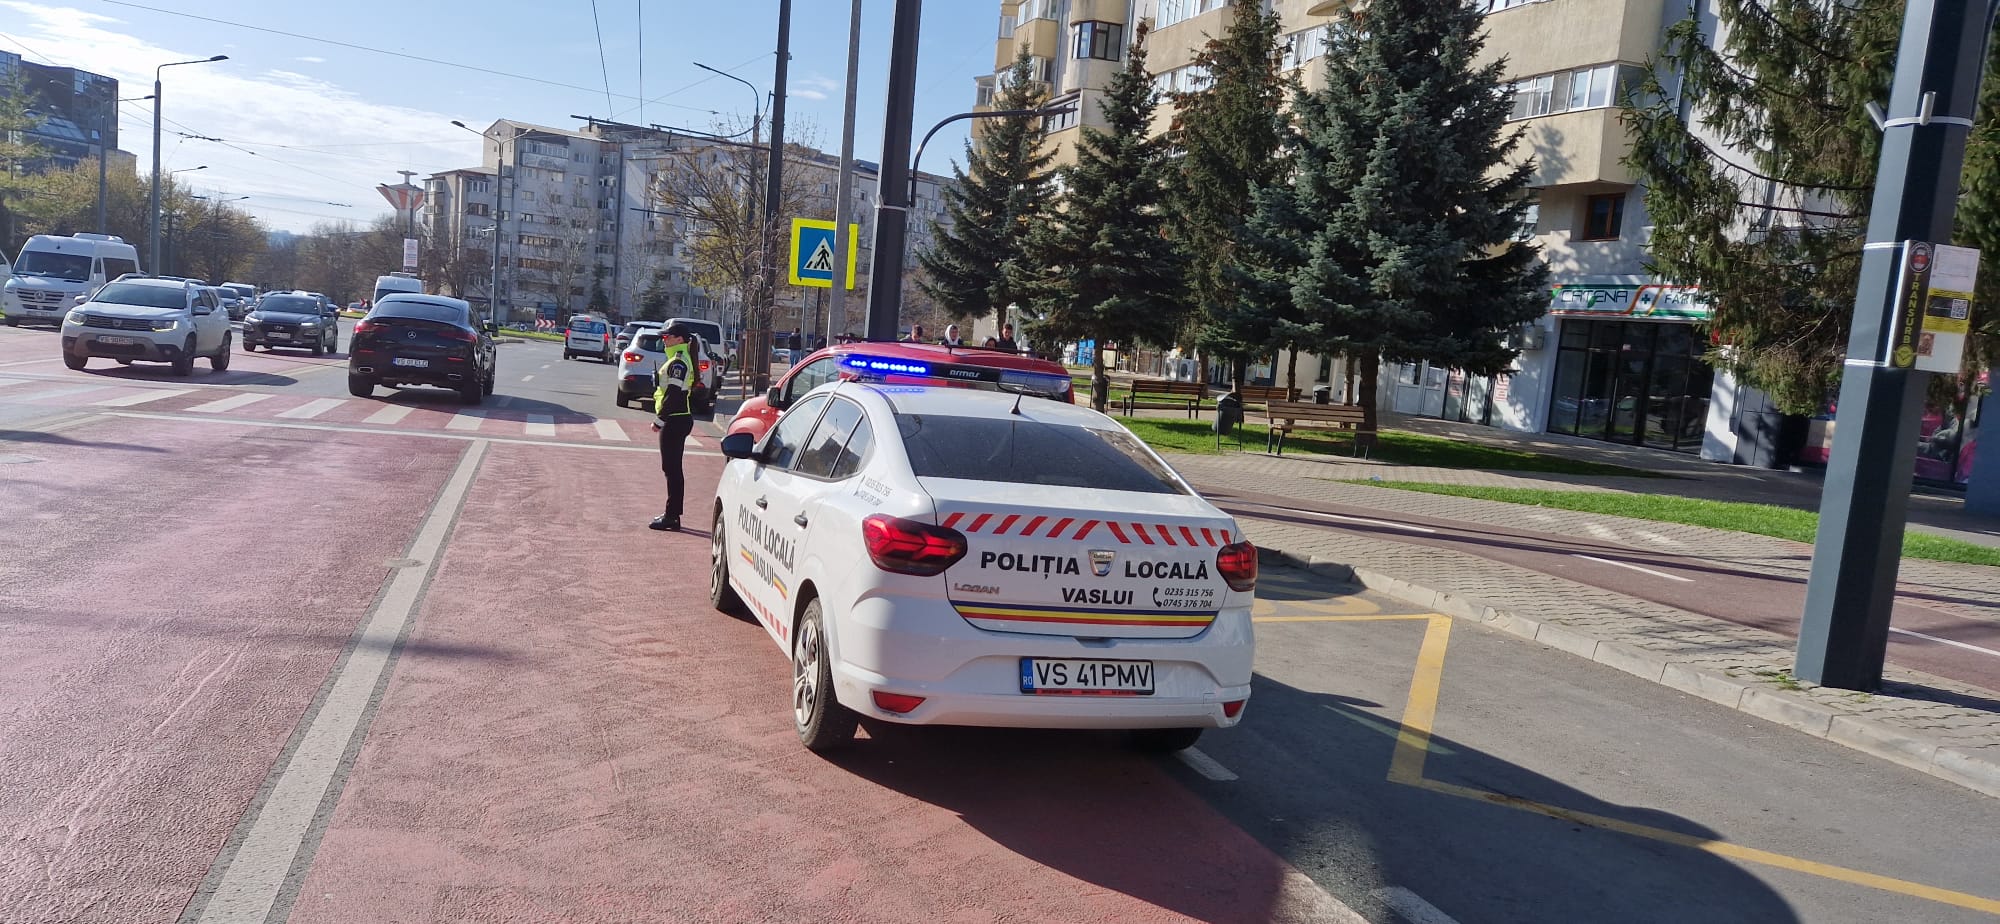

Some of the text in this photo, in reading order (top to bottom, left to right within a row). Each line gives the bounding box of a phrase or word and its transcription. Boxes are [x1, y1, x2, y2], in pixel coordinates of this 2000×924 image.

[1561, 290, 1628, 303] CATENA
[1903, 273, 1920, 344] TRANSURB
[752, 550, 774, 588] VASLUI
[981, 551, 1208, 580] POLIȚIA LOCALĂ
[954, 583, 999, 595] LOGAN
[1062, 588, 1134, 605] VASLUI
[1164, 588, 1214, 598] 0235 315 756
[1163, 599, 1212, 608] 0745 376 704
[1023, 676, 1033, 686] RO
[1036, 663, 1068, 686] VS
